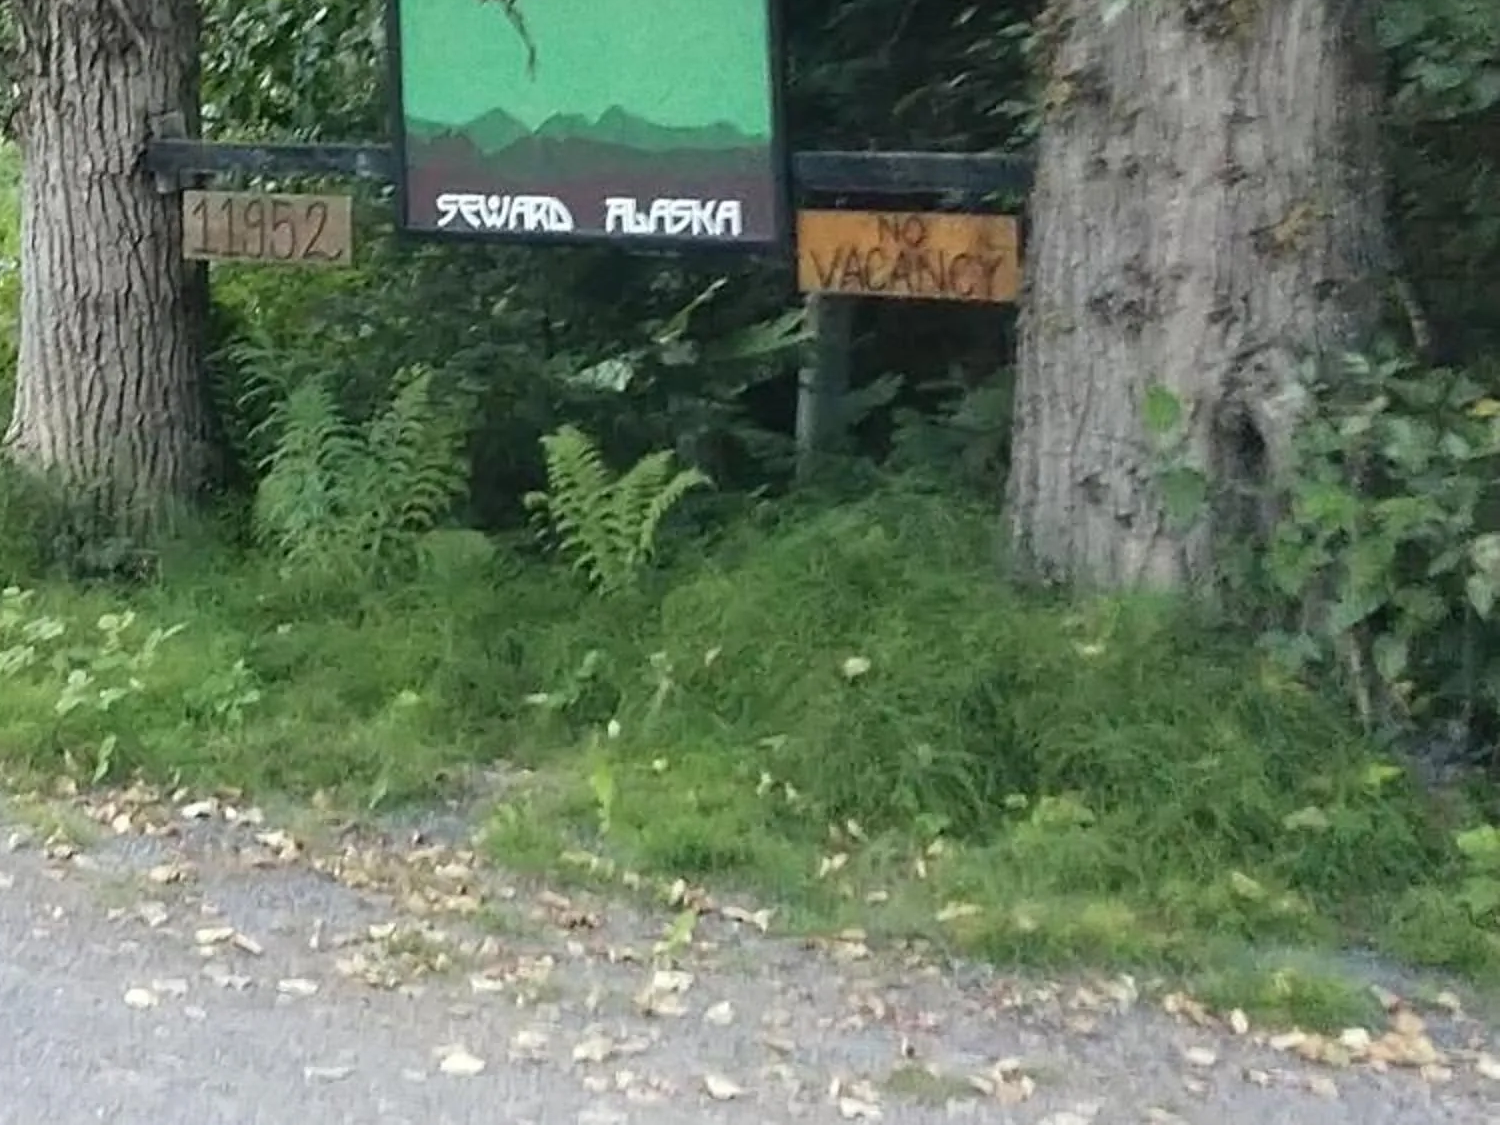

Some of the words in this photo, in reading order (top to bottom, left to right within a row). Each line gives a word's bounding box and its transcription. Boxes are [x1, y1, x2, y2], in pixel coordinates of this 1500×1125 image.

[192, 197, 342, 261] 11952
[436, 194, 573, 230] SEWARD
[605, 197, 741, 236] ALASKA
[878, 214, 926, 248] NO
[810, 243, 1004, 297] VACANCY
